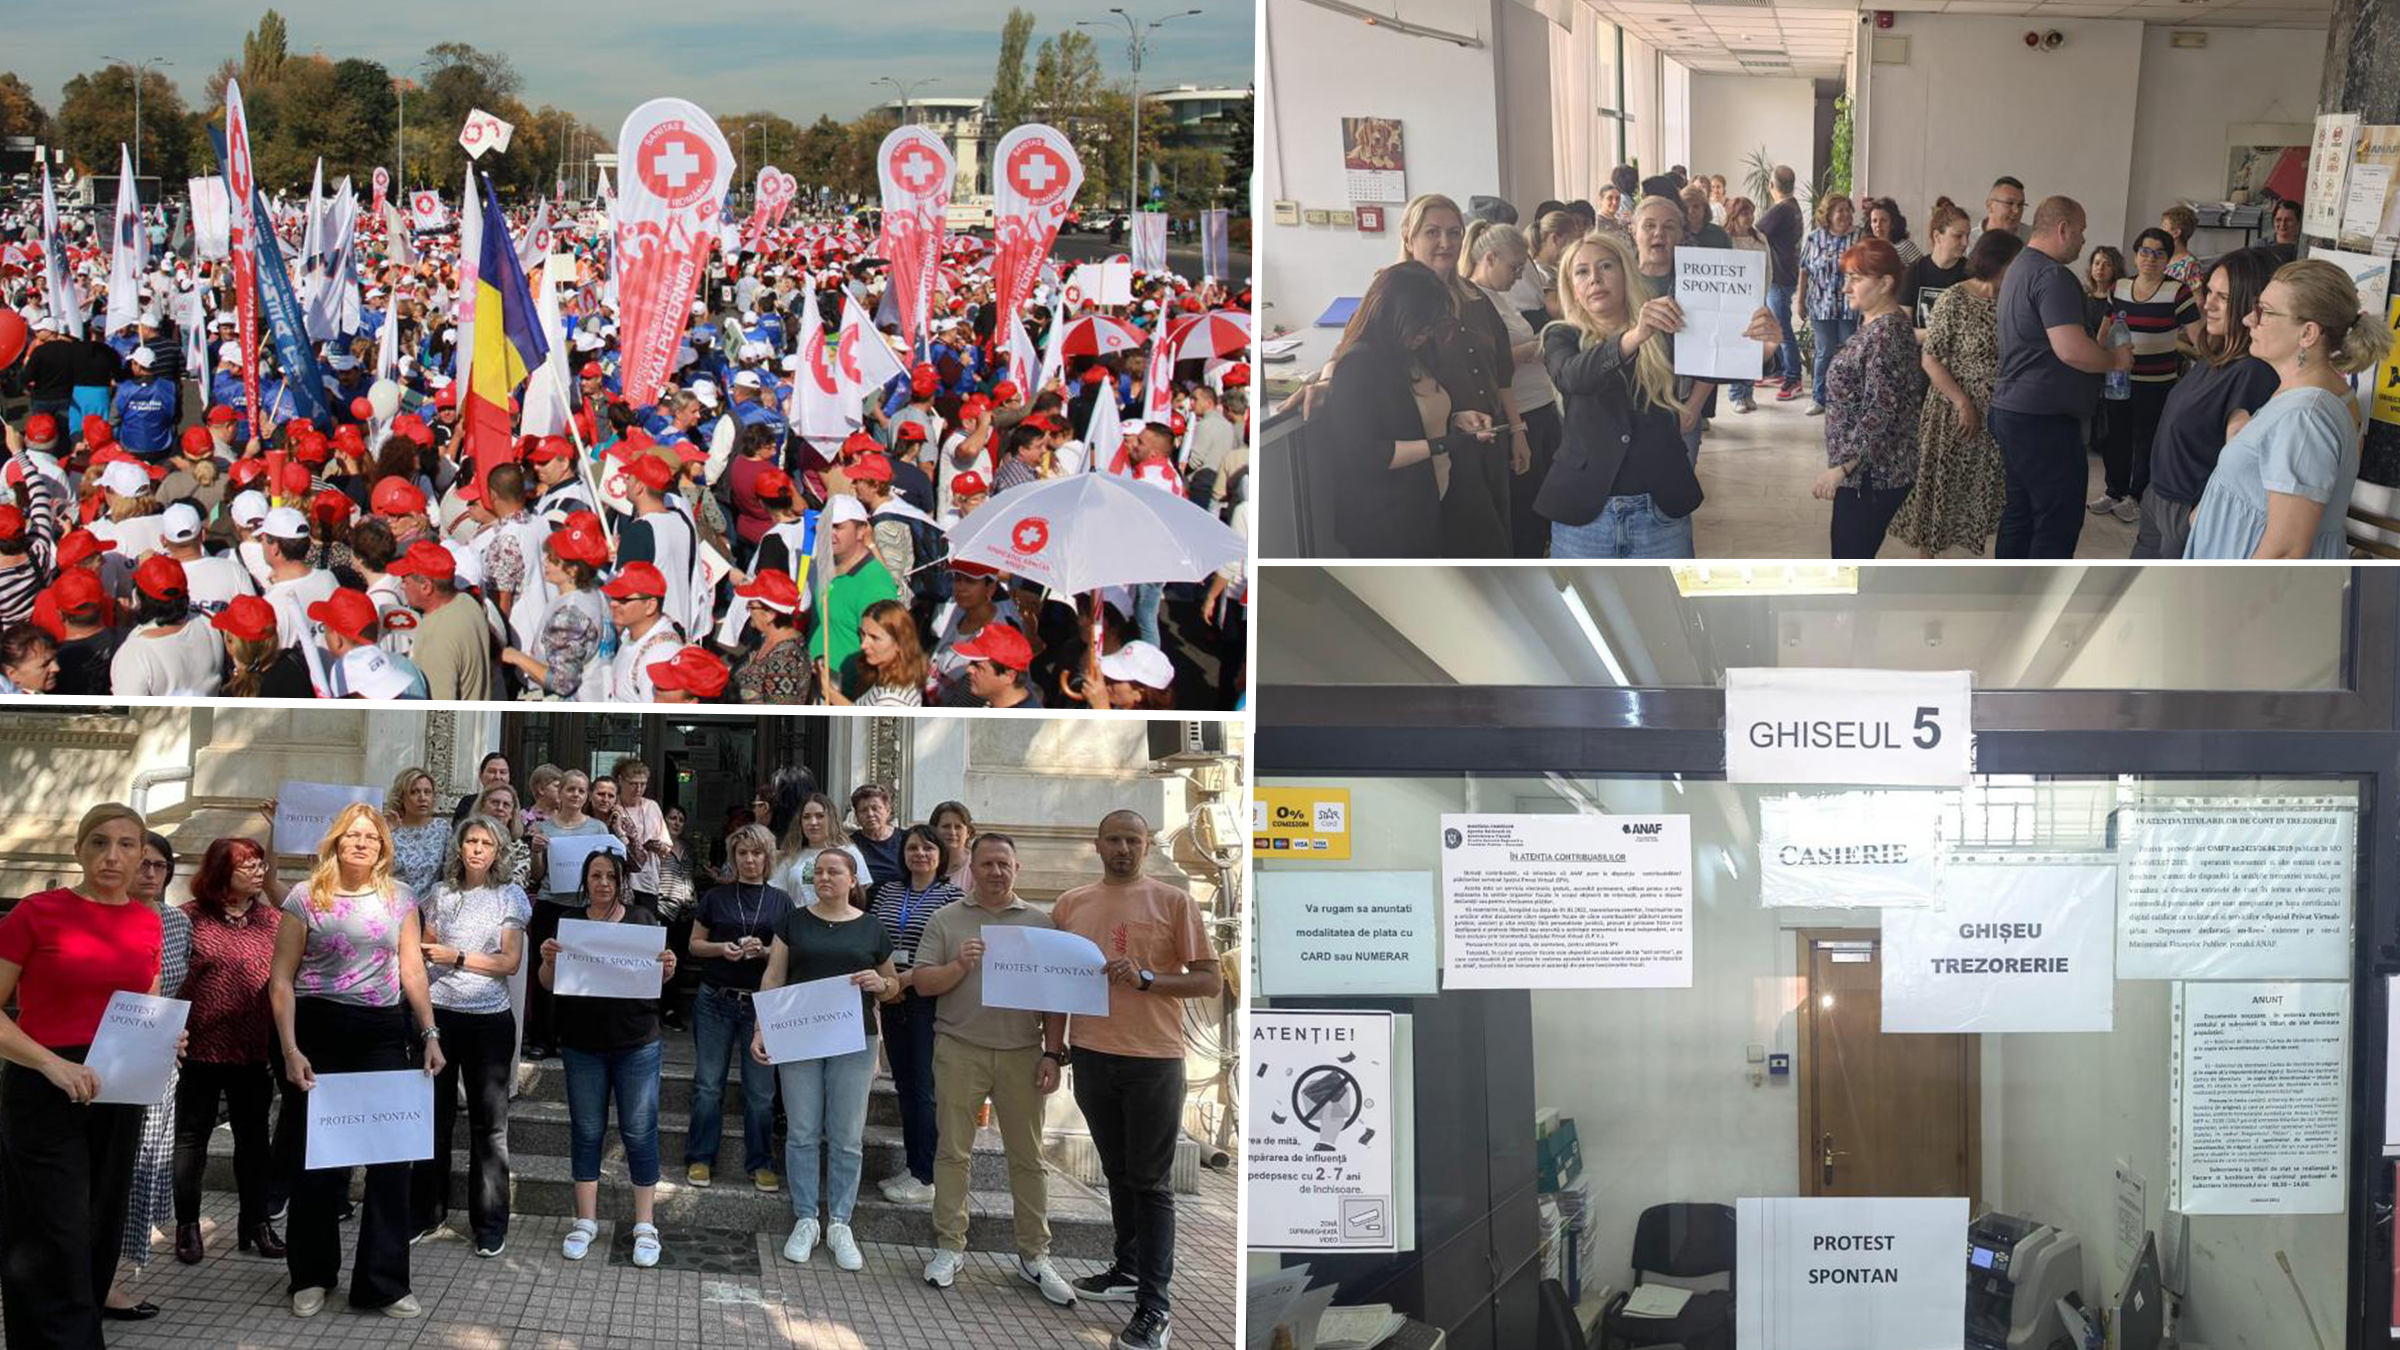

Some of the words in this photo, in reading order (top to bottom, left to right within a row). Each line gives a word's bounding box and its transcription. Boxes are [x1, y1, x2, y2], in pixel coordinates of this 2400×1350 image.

[644, 121, 681, 146] SANITAS
[1683, 262, 1746, 277] PROTEST
[1682, 279, 1752, 295] SPONTAN!
[657, 258, 695, 355] PUTERNICI
[1749, 721, 1902, 749] GHISEUL
[1912, 706, 1942, 750] 5
[286, 814, 324, 824] PROTEST
[1276, 806, 1304, 820] 0%
[1272, 820, 1309, 828] COMISION
[1632, 823, 1663, 834] ANAF
[1778, 844, 1908, 866] CASIERIE
[1305, 904, 1319, 913] Va
[1321, 906, 1354, 916] rugam
[1356, 905, 1369, 913] sa
[1371, 904, 1413, 913] anuntati
[1296, 928, 1355, 937] modalitatea
[1357, 928, 1371, 937] de
[1373, 928, 1398, 939] plata
[1958, 923, 2042, 944] GHIȘEU
[567, 952, 605, 965] PROTEST
[610, 956, 652, 967] SPONTAN
[1301, 952, 1331, 961] CARD
[1355, 952, 1409, 961] NUMERAR
[994, 962, 1040, 973] PROTEST
[1044, 965, 1095, 977] SPONTAN
[1930, 957, 2069, 974] TREZORERIE
[2252, 995, 2284, 1005] ANUNȚ
[114, 1001, 157, 1016] PROTEST
[109, 1015, 155, 1029] SPONTAN
[770, 1017, 808, 1031] PROTEST
[812, 1010, 854, 1023] SPONTAN
[1253, 1027, 1355, 1044] ATENȚIE!
[320, 1114, 365, 1126] PROTEST
[372, 1110, 421, 1123] SPONTAN
[1263, 1136, 1276, 1145] de
[1291, 1153, 1303, 1162] de
[1305, 1153, 1347, 1165] influență
[1248, 1172, 1299, 1182] pedepsesc
[1315, 1167, 1325, 1181] 2
[1333, 1167, 1343, 1181] 7
[1346, 1172, 1361, 1181] ani
[1299, 1185, 1311, 1194] de
[1313, 1184, 1364, 1194] închisoare.
[1319, 1236, 1339, 1244] VIDEO
[1813, 1235, 1895, 1251] PROTEST
[1808, 1268, 1898, 1284] SPONTAN
